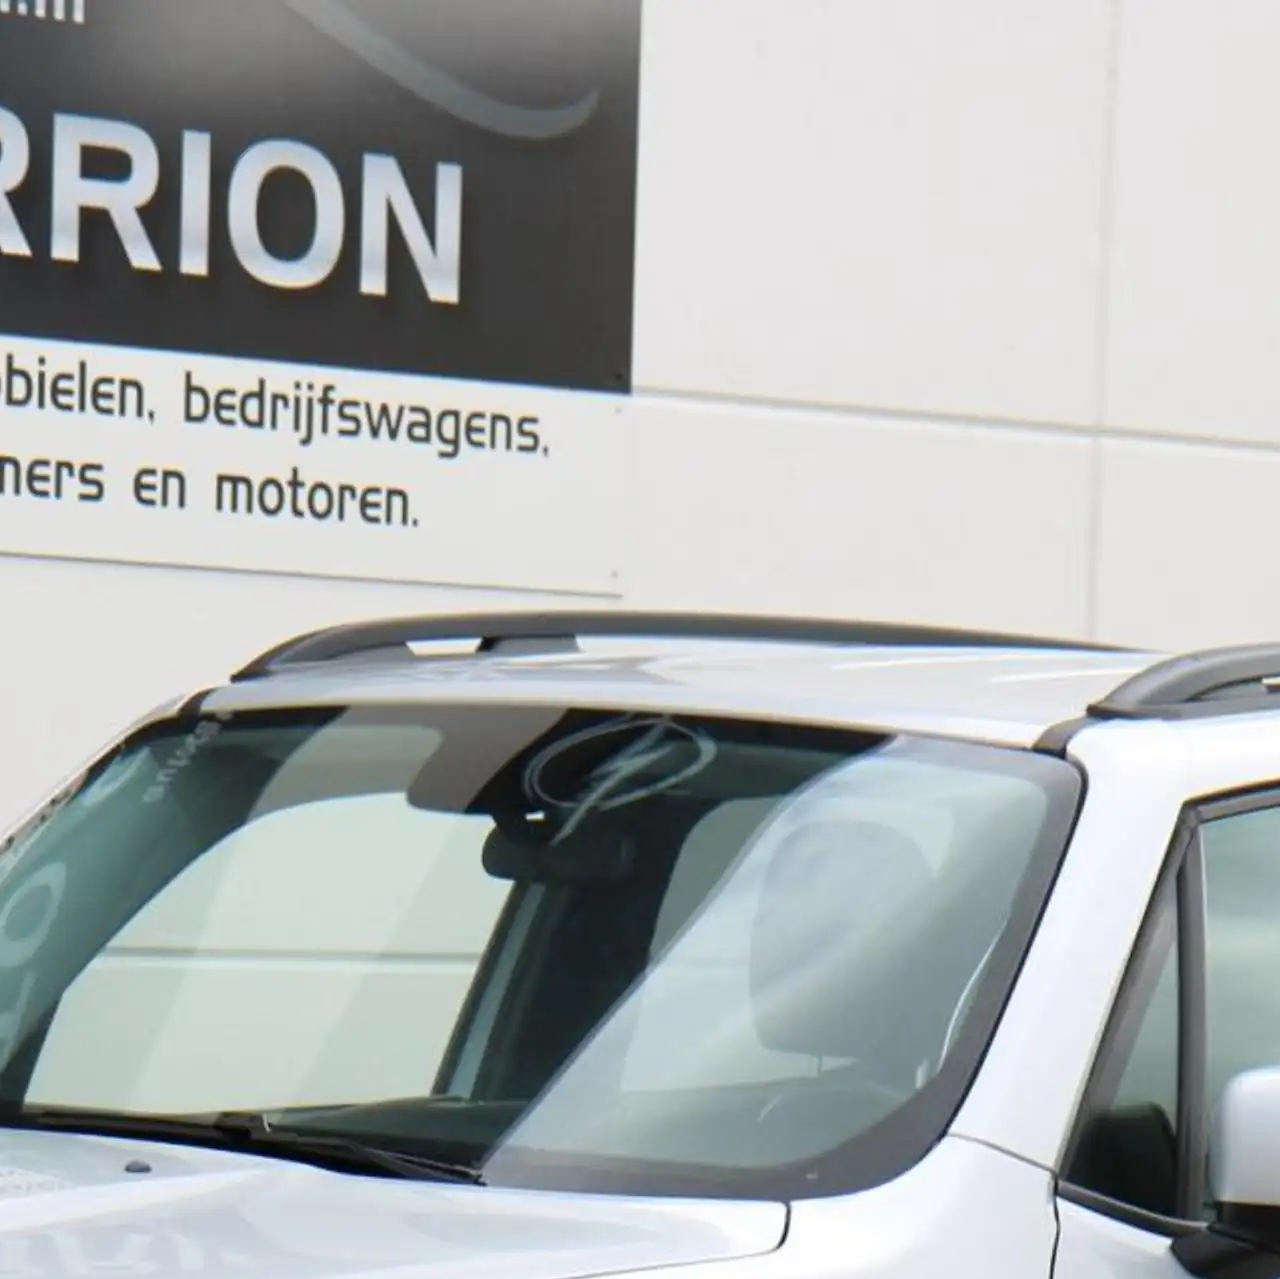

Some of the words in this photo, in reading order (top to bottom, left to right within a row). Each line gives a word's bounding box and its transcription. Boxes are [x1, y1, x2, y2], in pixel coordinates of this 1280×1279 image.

[185, 371, 551, 458] bedrijfswagens,
[134, 469, 186, 508] en
[216, 474, 420, 528] motoren.
